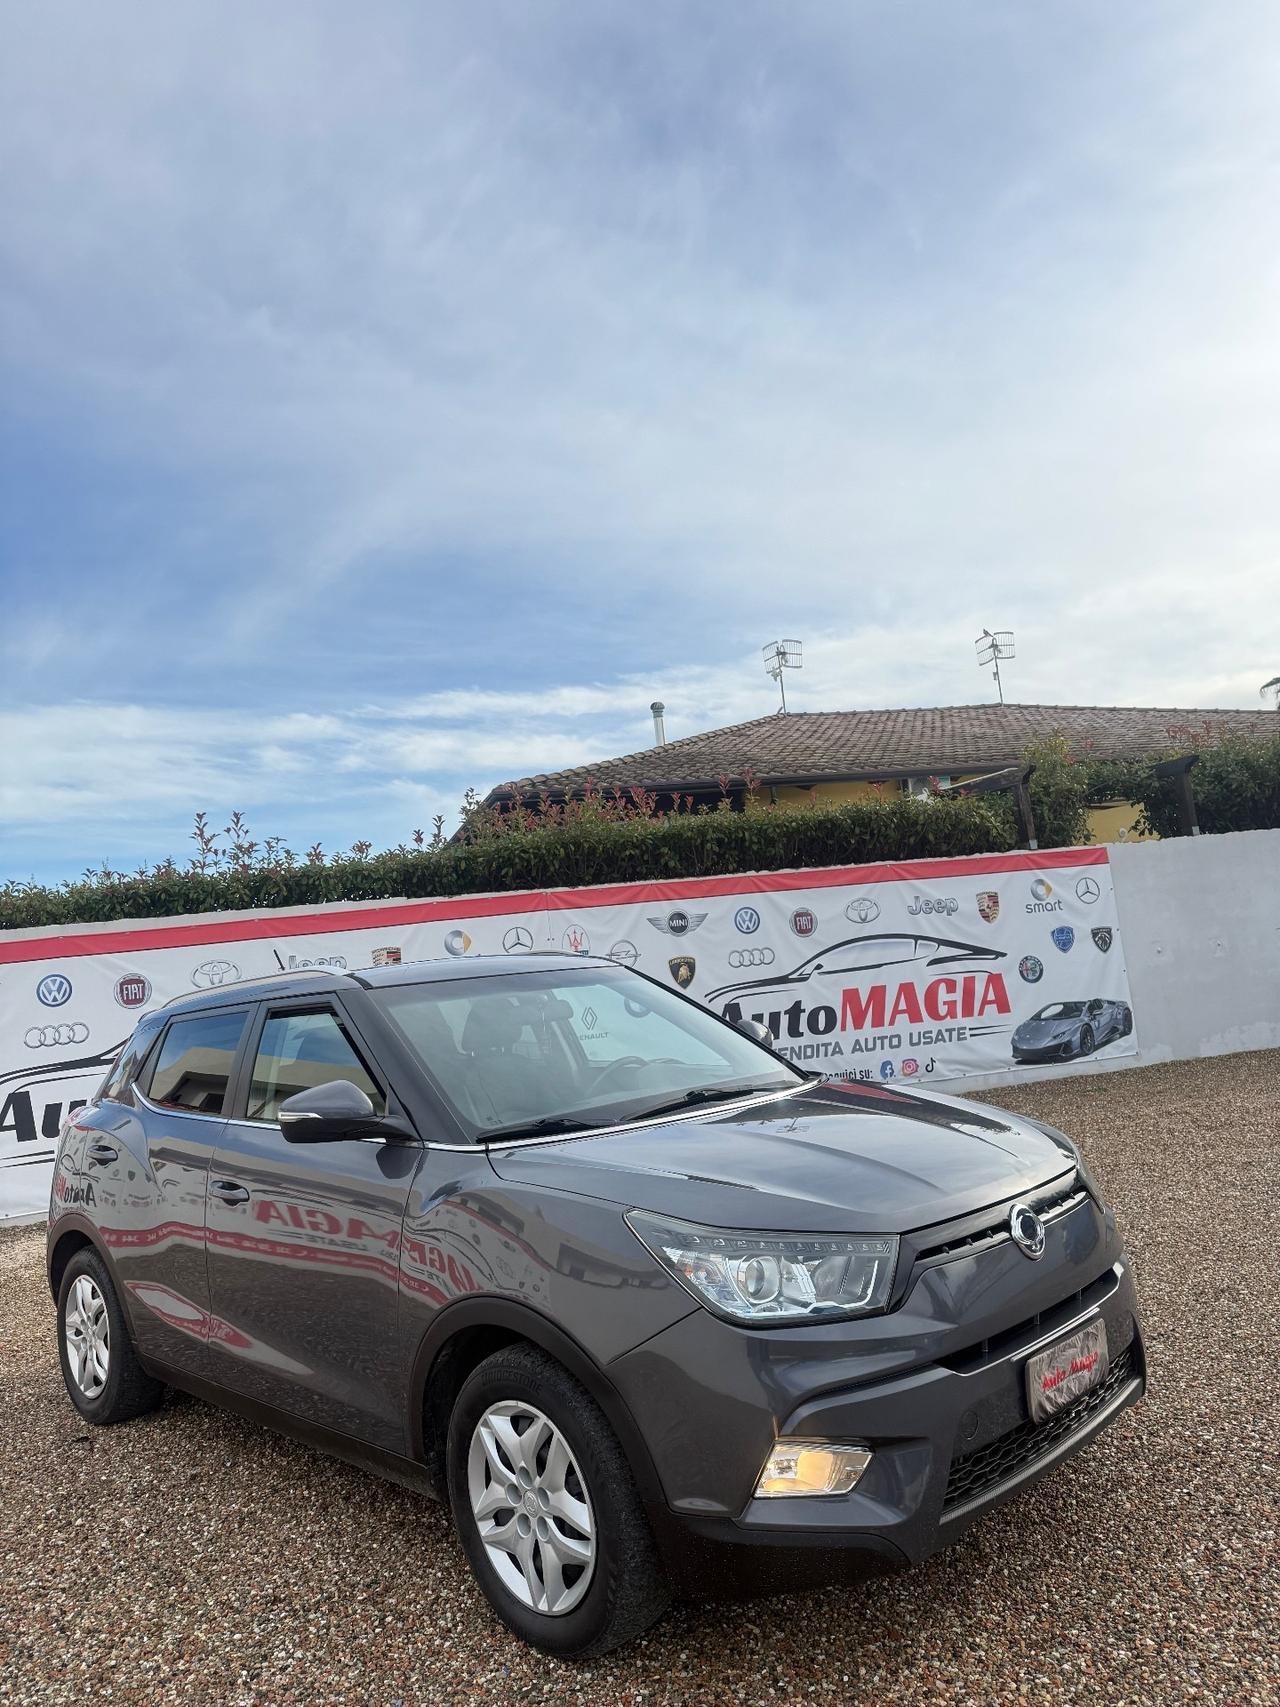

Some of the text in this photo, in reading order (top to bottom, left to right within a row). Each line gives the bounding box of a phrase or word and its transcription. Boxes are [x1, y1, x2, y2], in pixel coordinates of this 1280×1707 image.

[907, 895, 959, 916] Jeep
[1025, 899, 1064, 914] smart
[669, 918, 688, 928] MINI
[796, 915, 812, 931] FIAT
[122, 983, 144, 1001] FIAT
[579, 1031, 609, 1041] ENAULT
[774, 1026, 968, 1062] ENDITA AUTO USATE
